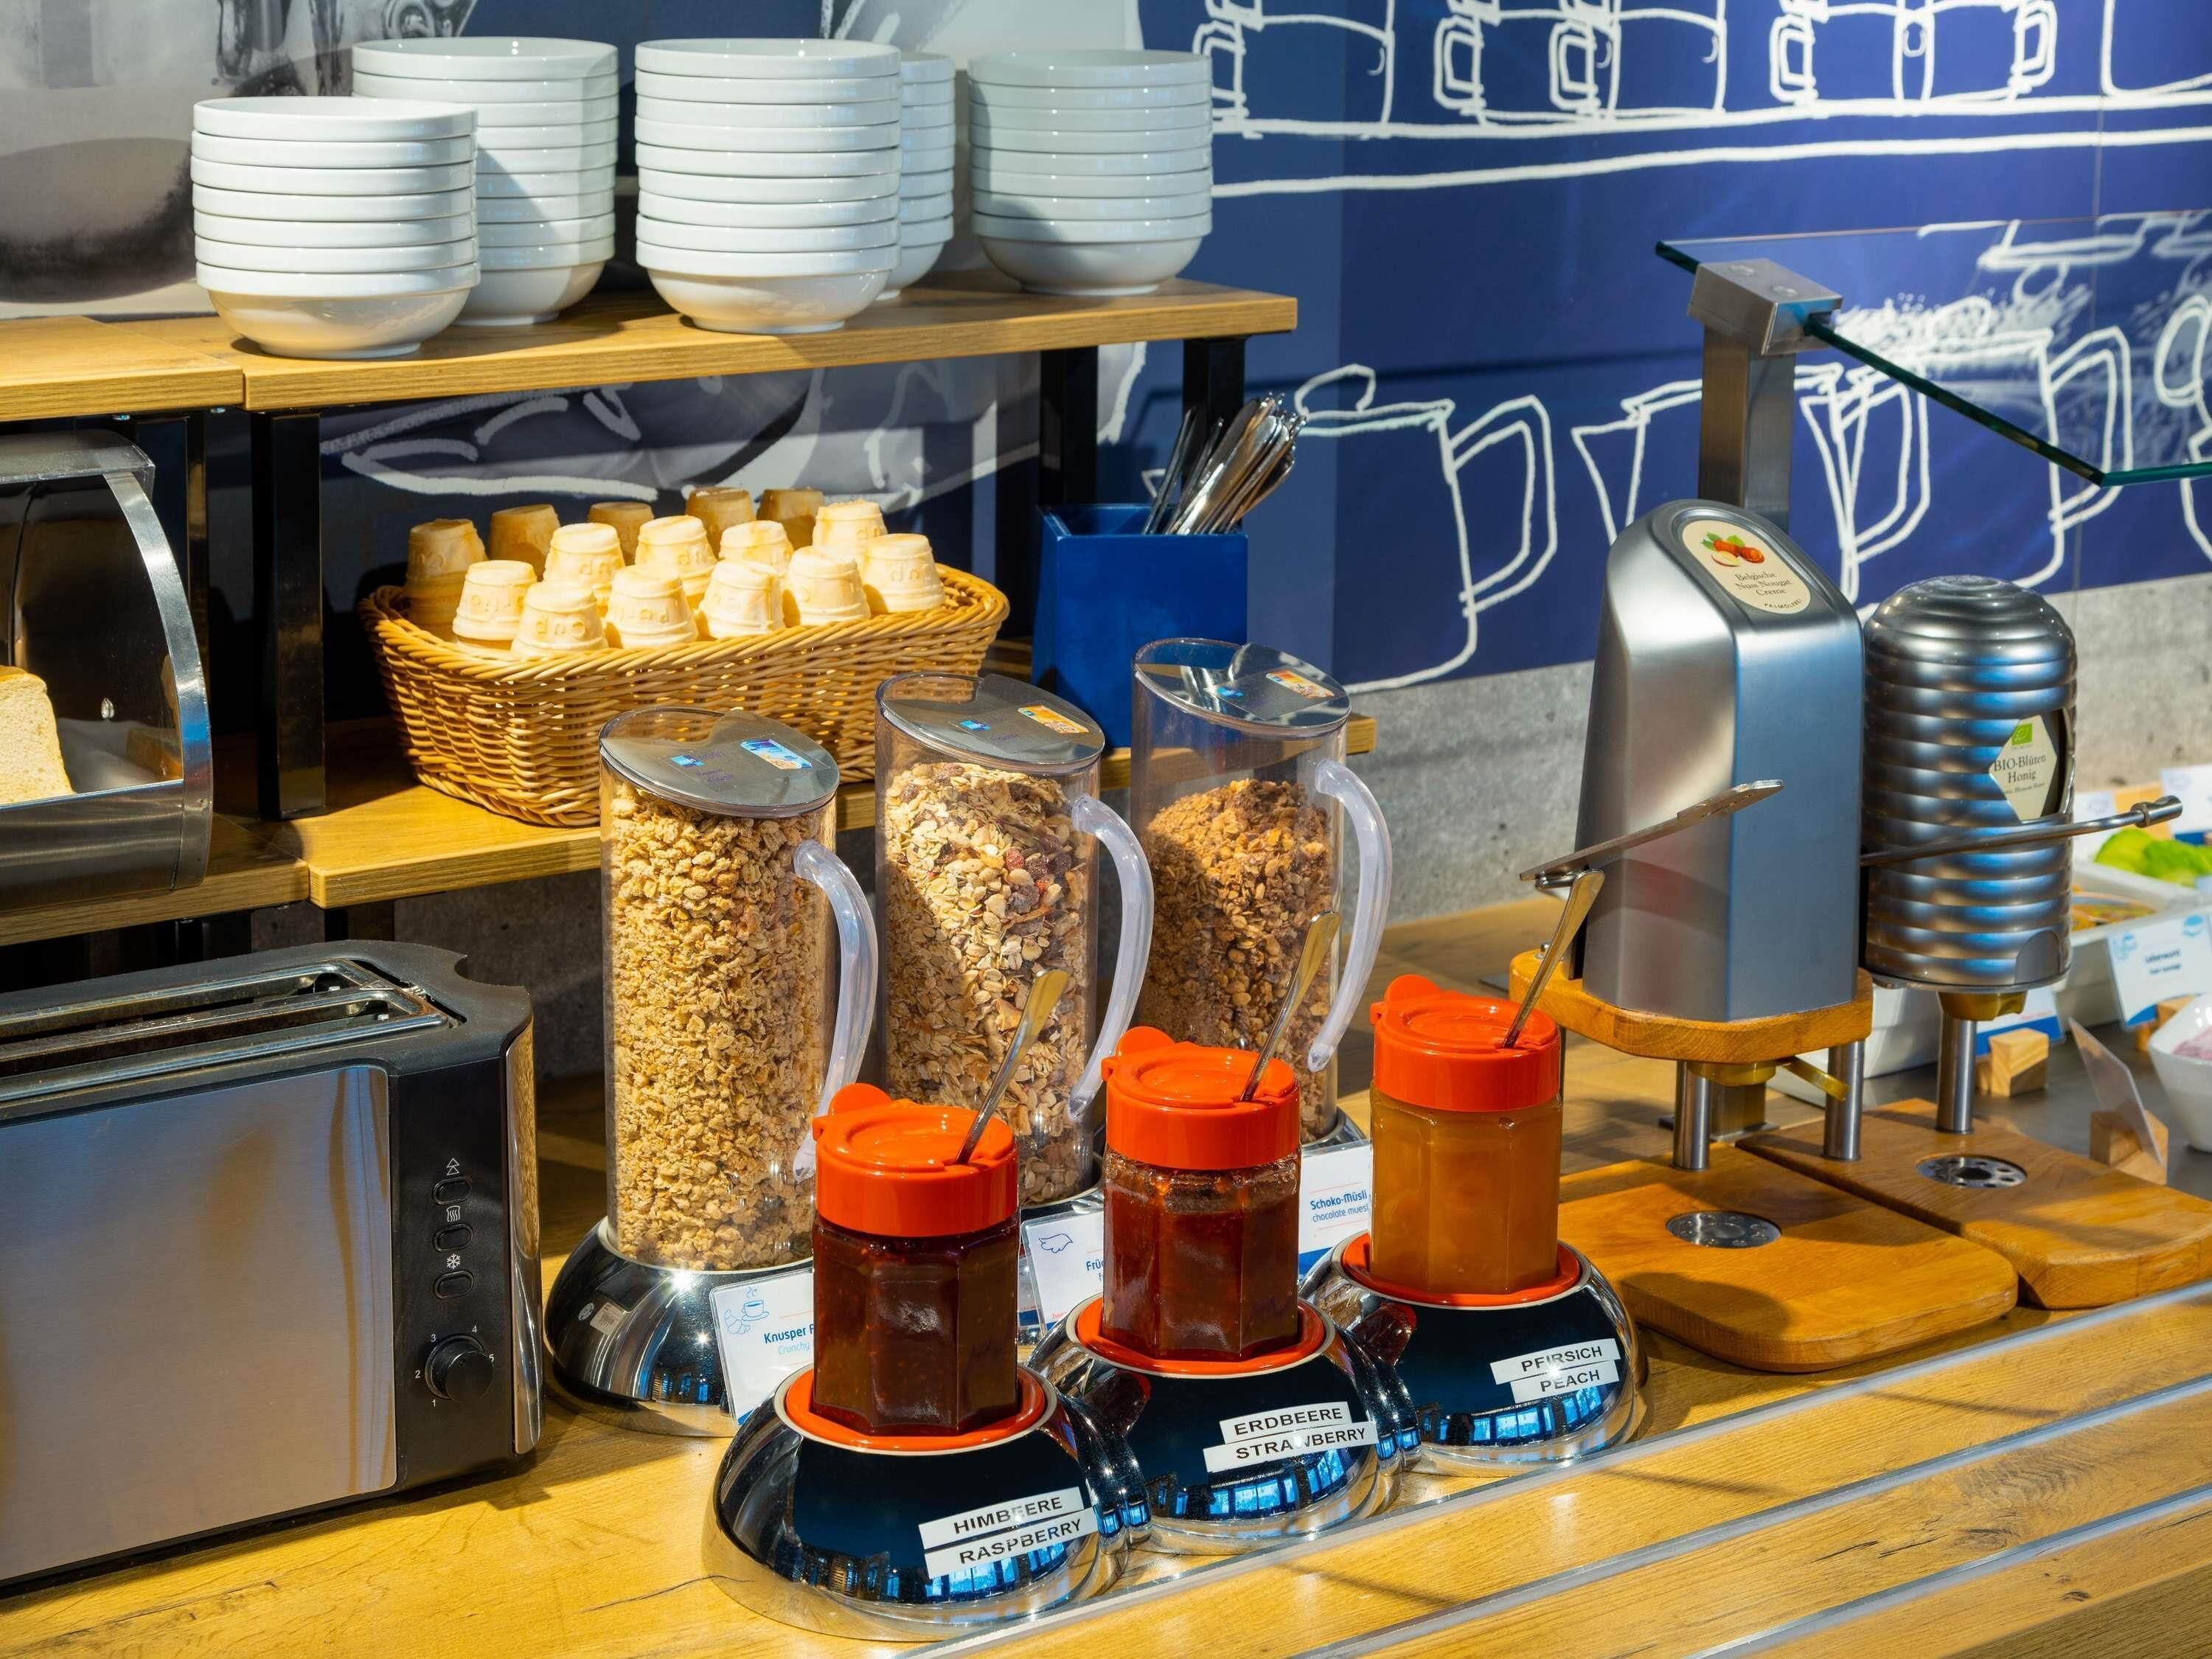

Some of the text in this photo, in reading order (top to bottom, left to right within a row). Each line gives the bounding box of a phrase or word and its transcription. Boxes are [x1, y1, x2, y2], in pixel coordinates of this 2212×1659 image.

[1756, 588, 1787, 597] Creme
[1994, 754, 2046, 772] BIO-Blüten
[2008, 770, 2037, 784] Honig
[1310, 1189, 1368, 1211] Schoko-Müsli
[1312, 1208, 1346, 1222] chocolate
[431, 1333, 437, 1343] 3
[763, 1326, 807, 1344] Knusper
[778, 1341, 810, 1355] Crunchy
[489, 1354, 495, 1363] 5
[1521, 1346, 1602, 1372] PFIRSICH
[414, 1370, 421, 1379] 2
[1540, 1369, 1600, 1392] PEACH
[1234, 1408, 1343, 1436] ERDBEERE
[953, 1496, 1063, 1534] HIMBEERE
[959, 1519, 1082, 1565] RASPBERRY
